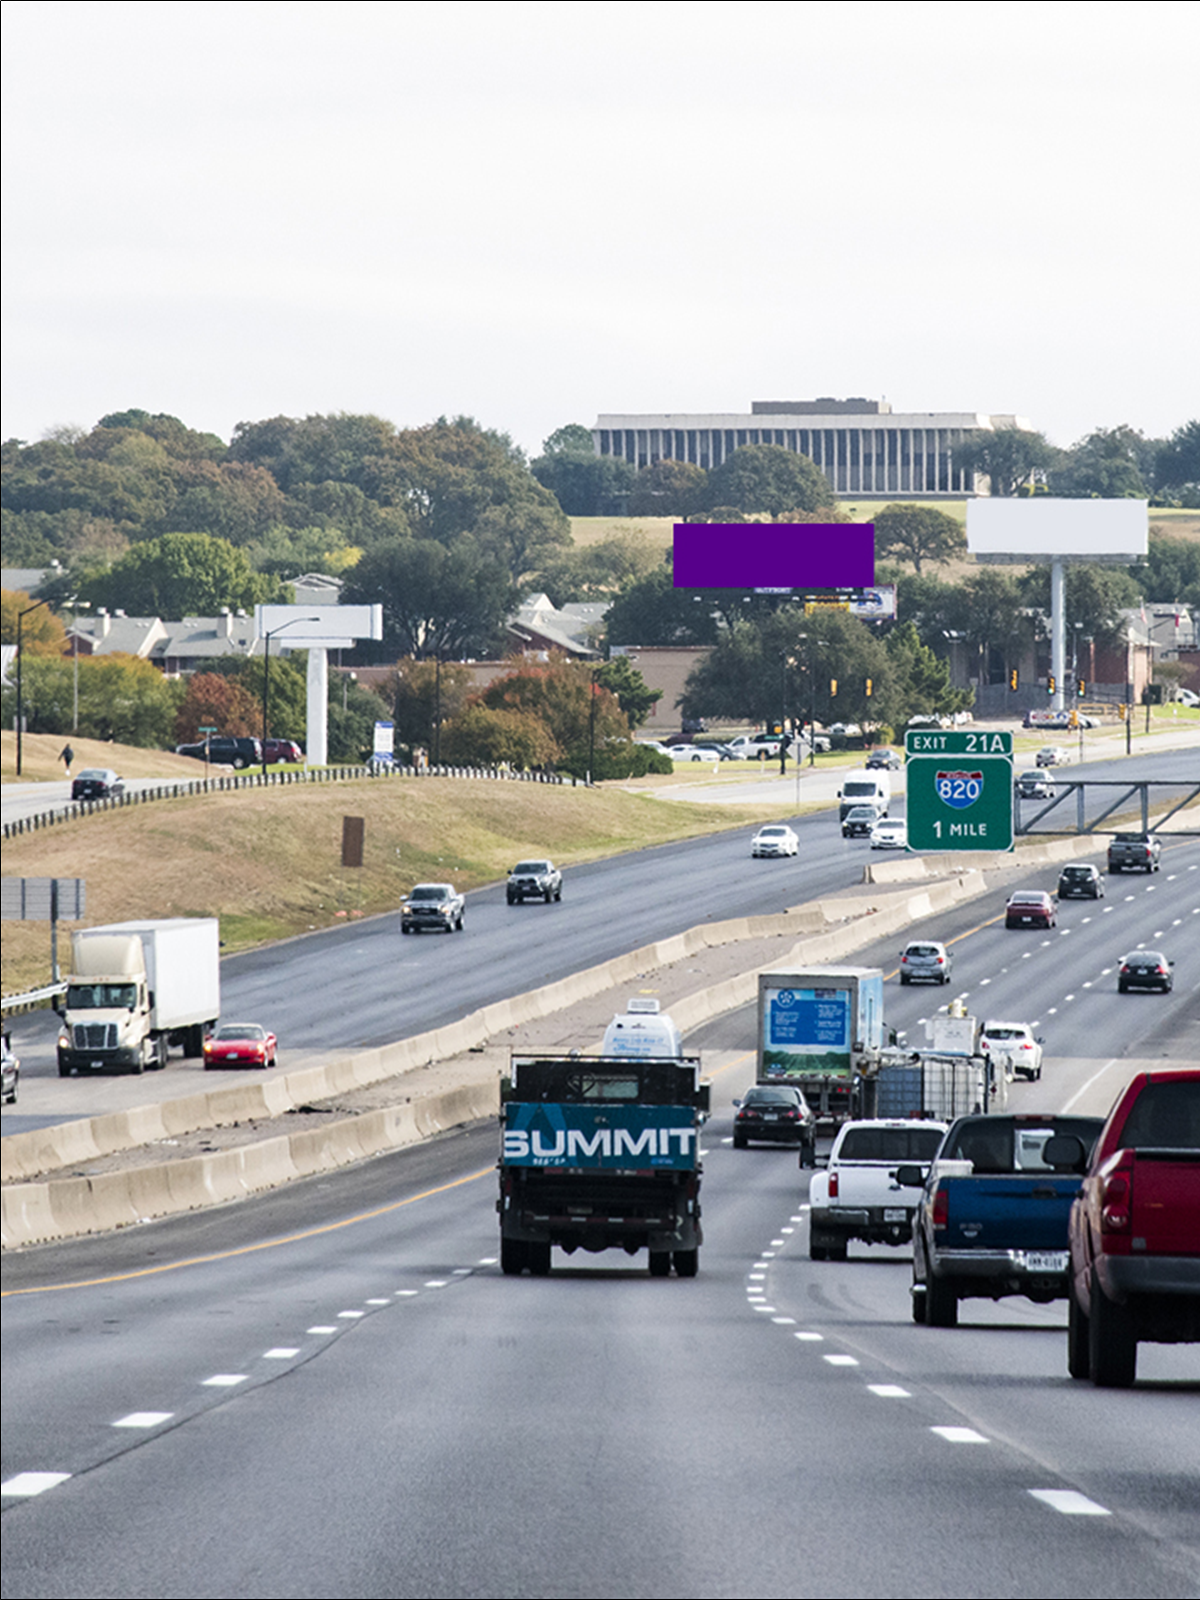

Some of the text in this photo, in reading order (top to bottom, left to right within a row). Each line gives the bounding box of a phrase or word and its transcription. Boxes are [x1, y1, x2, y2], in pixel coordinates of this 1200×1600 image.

[913, 734, 1005, 752] EXIT 21A
[940, 780, 980, 799] 820
[933, 820, 987, 838] 1 MILE
[503, 1127, 696, 1158] SUMMIT
